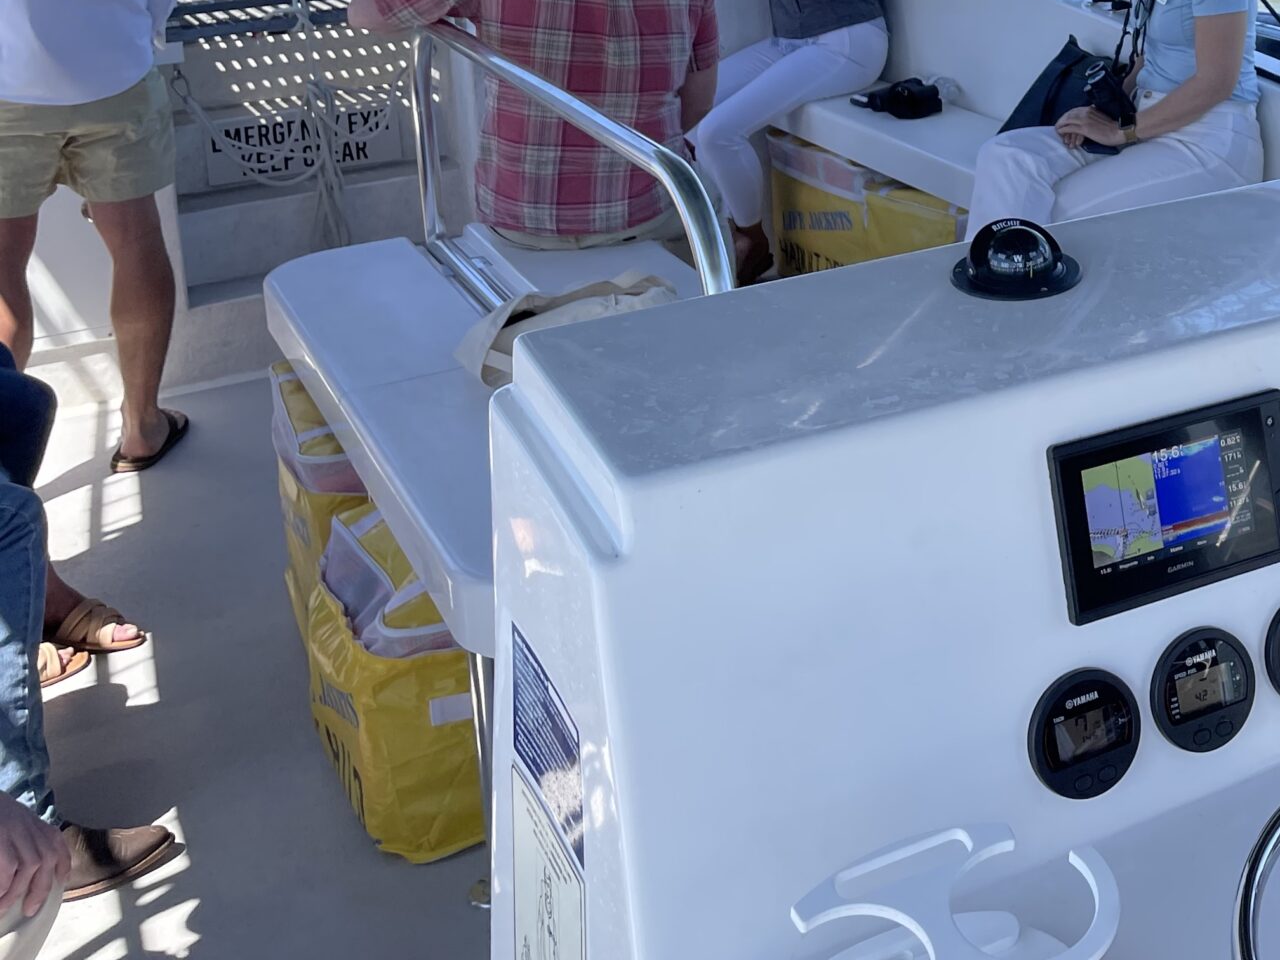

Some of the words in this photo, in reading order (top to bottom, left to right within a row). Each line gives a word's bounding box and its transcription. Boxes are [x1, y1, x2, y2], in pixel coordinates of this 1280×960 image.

[211, 114, 340, 153] EMERGENY
[303, 141, 368, 167] CAR
[991, 220, 1021, 232] RITCHIE
[1012, 254, 1023, 263] W
[1167, 560, 1195, 574] GARMIN
[1192, 648, 1217, 665] YAMAHA
[1072, 690, 1099, 707] YAMAHA
